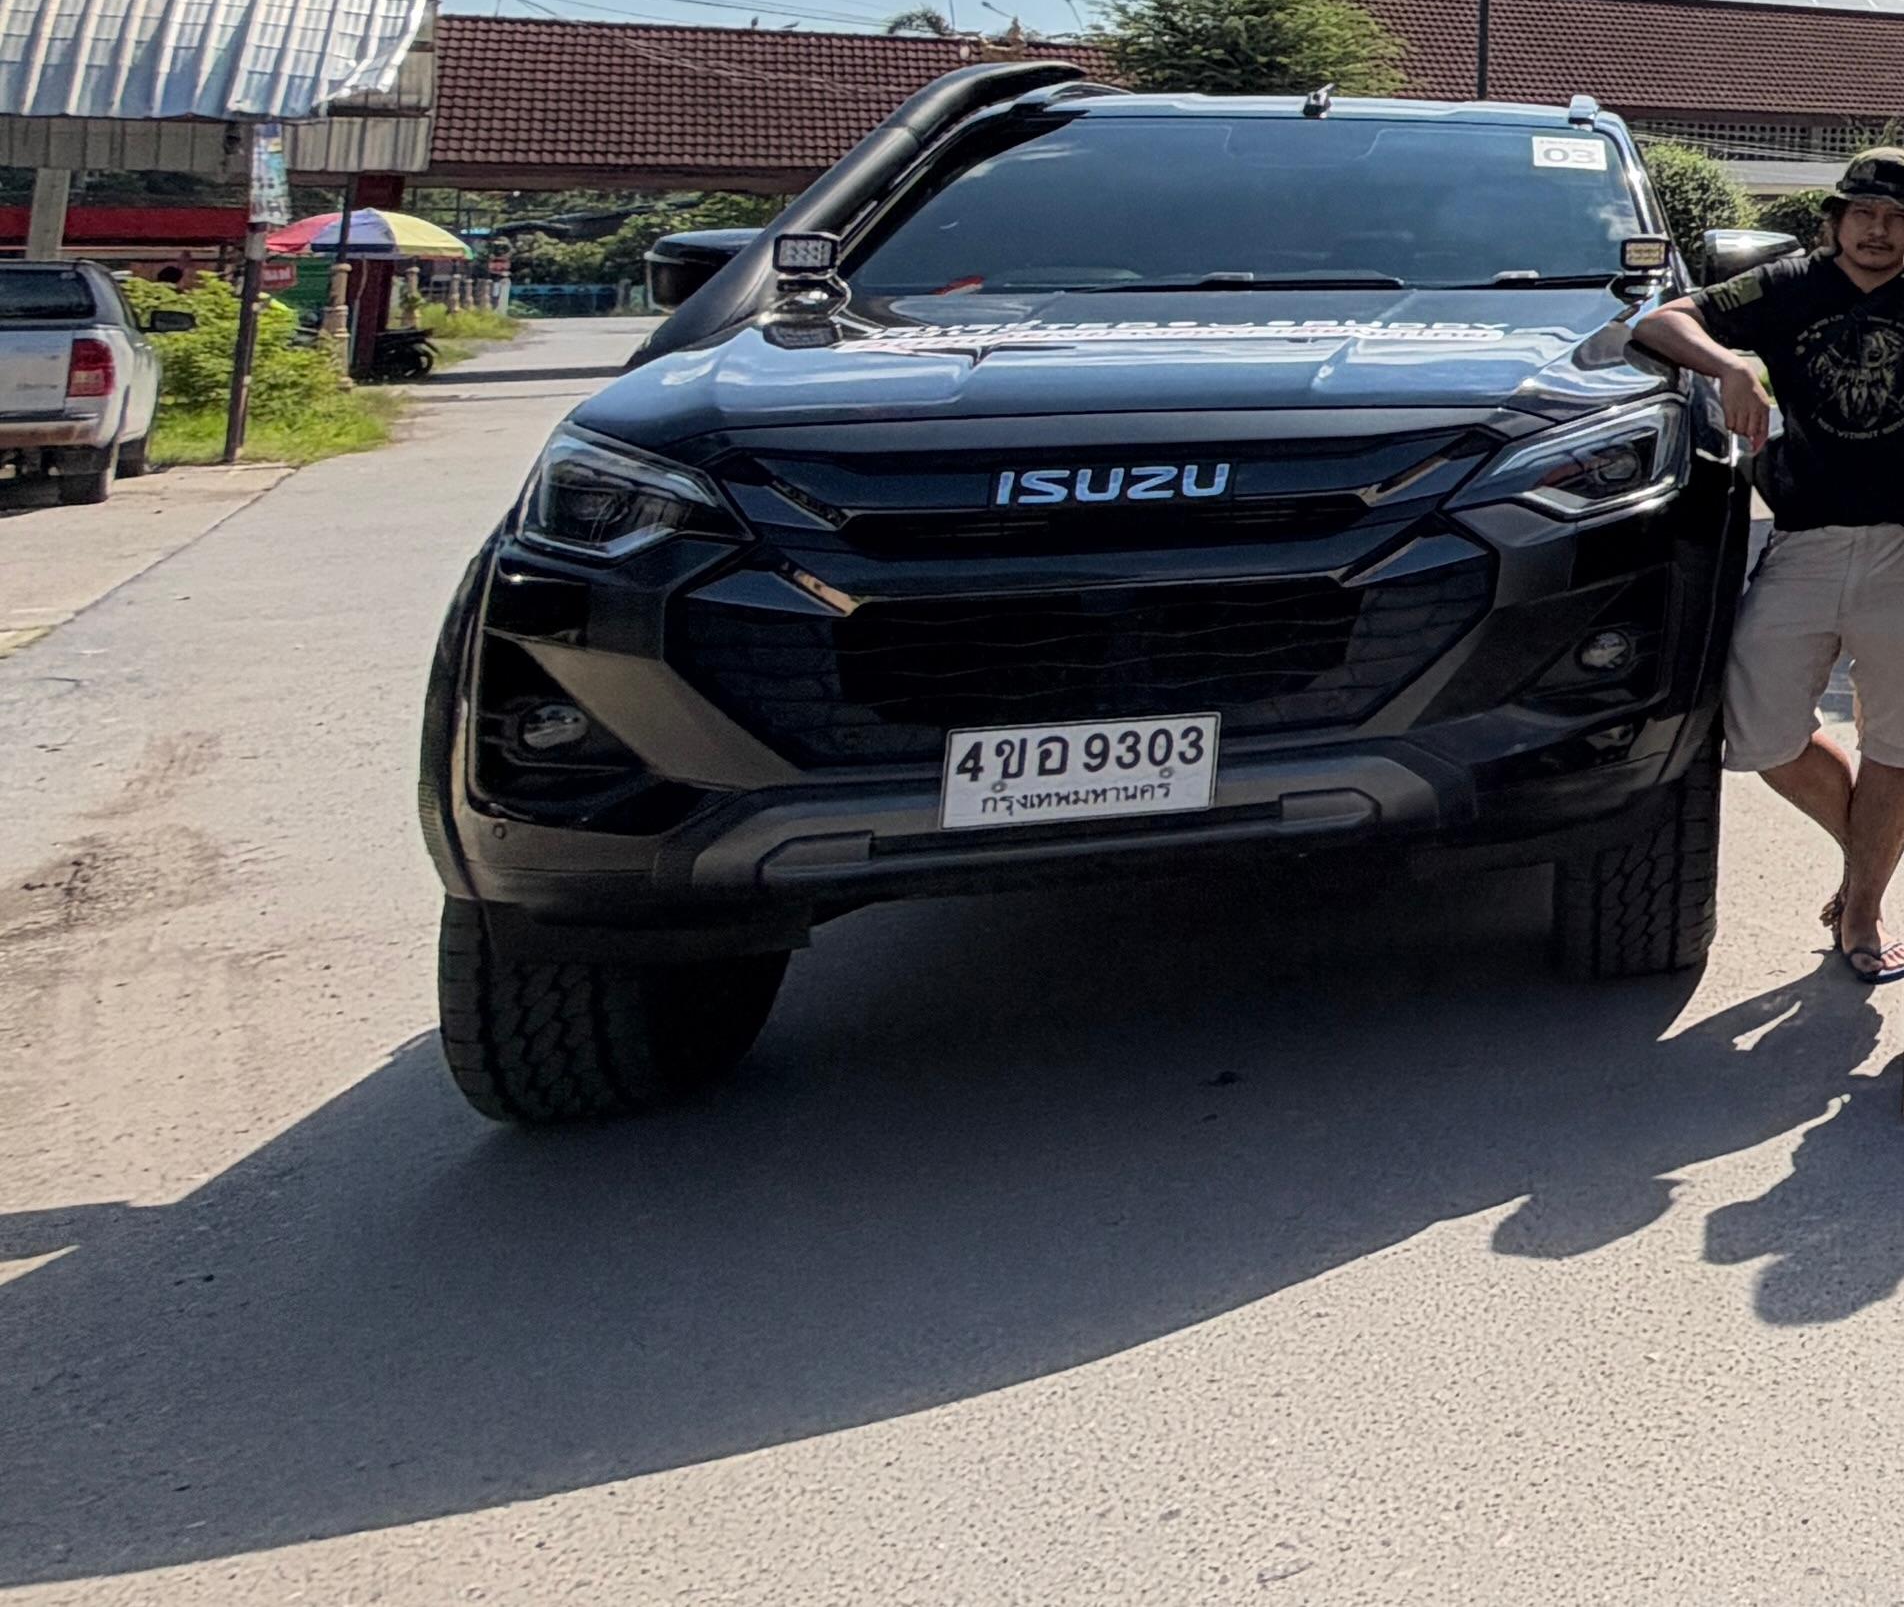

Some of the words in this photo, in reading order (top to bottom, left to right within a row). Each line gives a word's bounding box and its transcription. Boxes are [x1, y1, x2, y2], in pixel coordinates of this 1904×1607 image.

[1543, 147, 1597, 163] 03
[995, 462, 1230, 506] ISUZU
[956, 735, 1069, 783] 4ขอ
[1083, 725, 1205, 774] 9303
[981, 780, 1172, 818] กรุงเทพมหานคร
